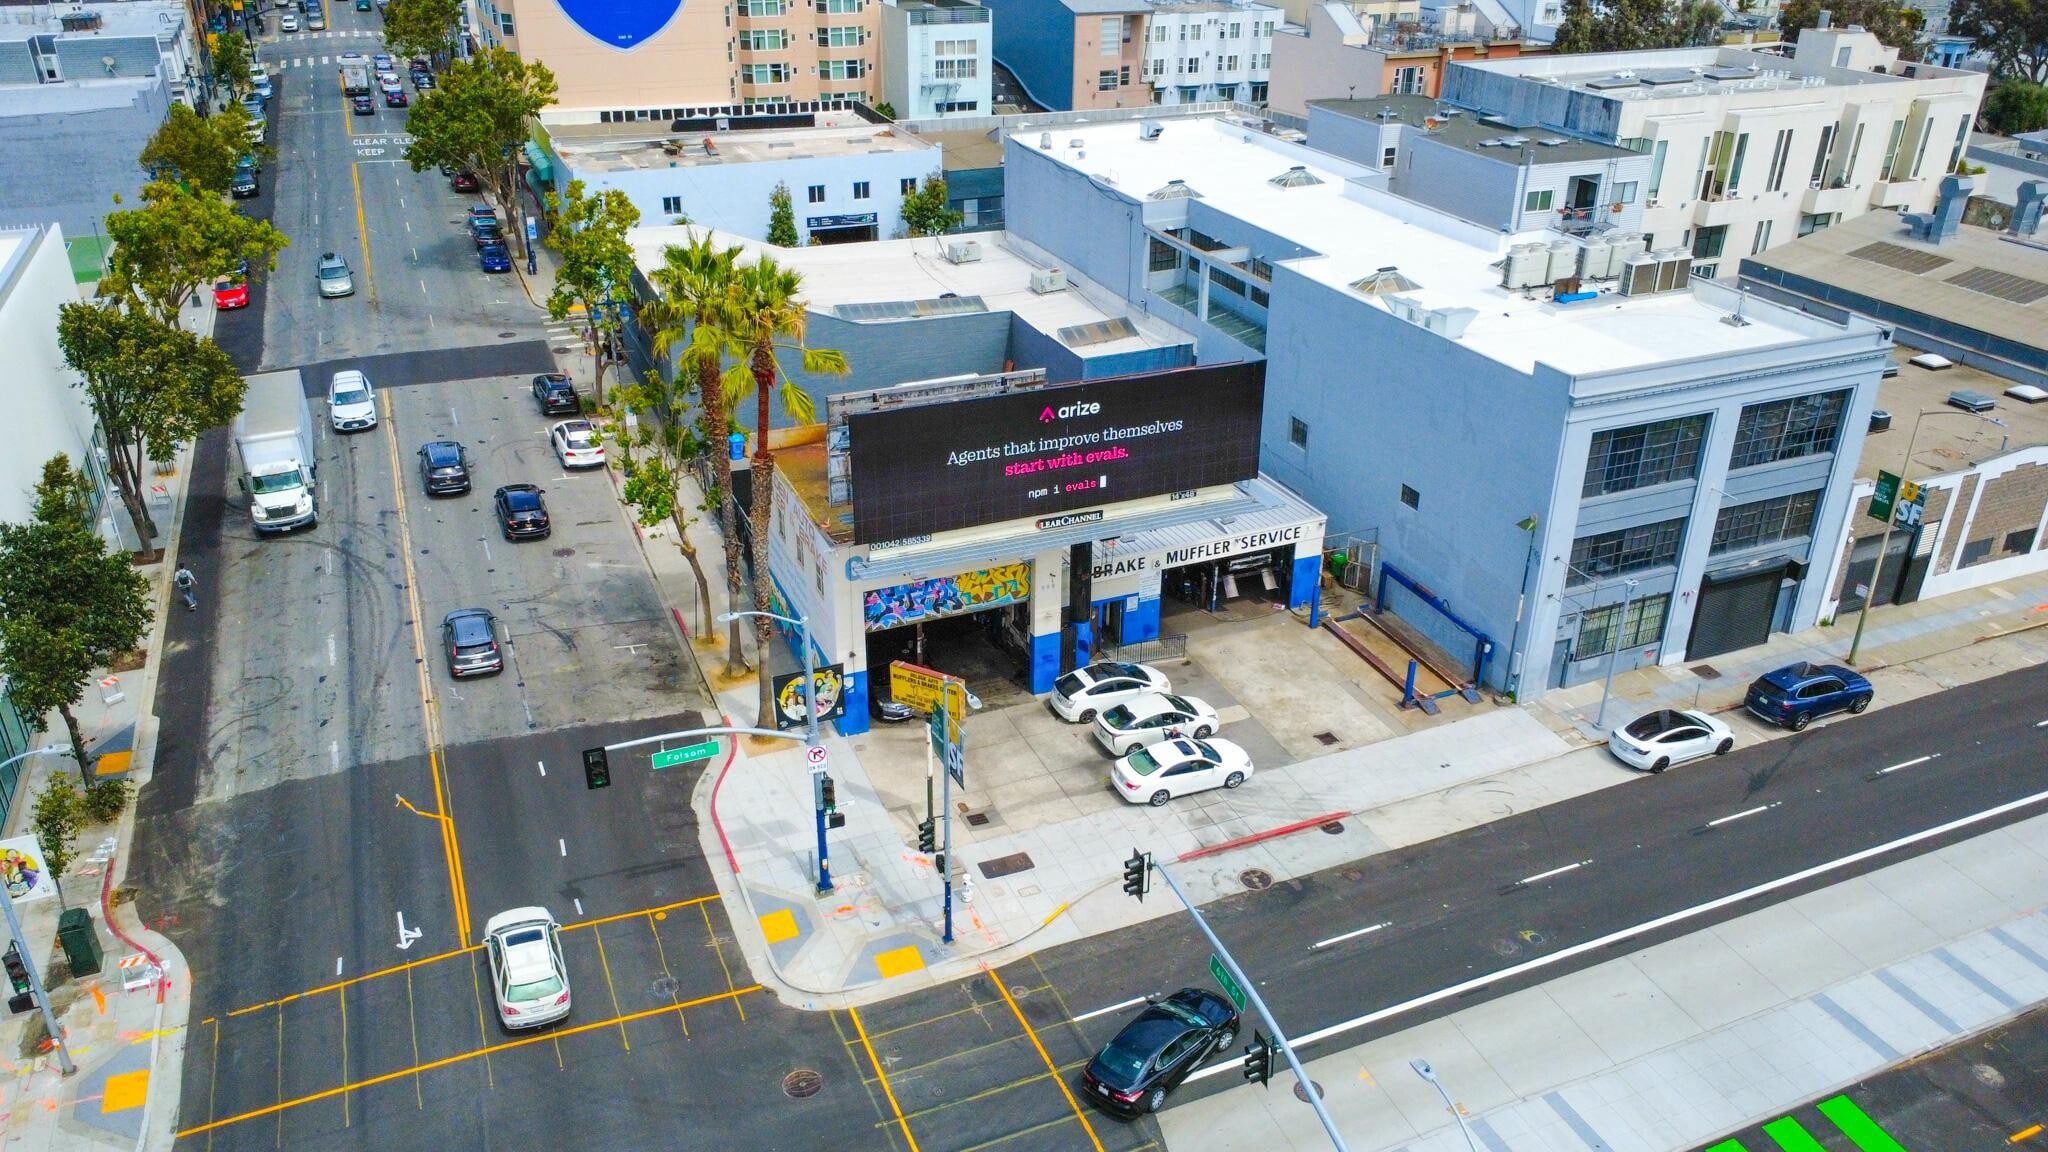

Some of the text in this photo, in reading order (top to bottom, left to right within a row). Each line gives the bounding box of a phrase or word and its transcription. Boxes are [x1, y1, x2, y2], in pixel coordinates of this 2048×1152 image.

[353, 137, 418, 146] CLEAR CLEA
[357, 148, 385, 157] KEEP
[1058, 401, 1101, 419] arize
[947, 418, 1184, 466] Agents that improve themselves
[1005, 446, 1129, 477] start with evals.
[1028, 479, 1097, 499] npm i evals
[1896, 499, 1922, 525] SF
[870, 534, 931, 551] 001042 585339
[1094, 527, 1302, 579] BRAKE & MUFFLER SERVICE
[666, 748, 706, 763] Folsom
